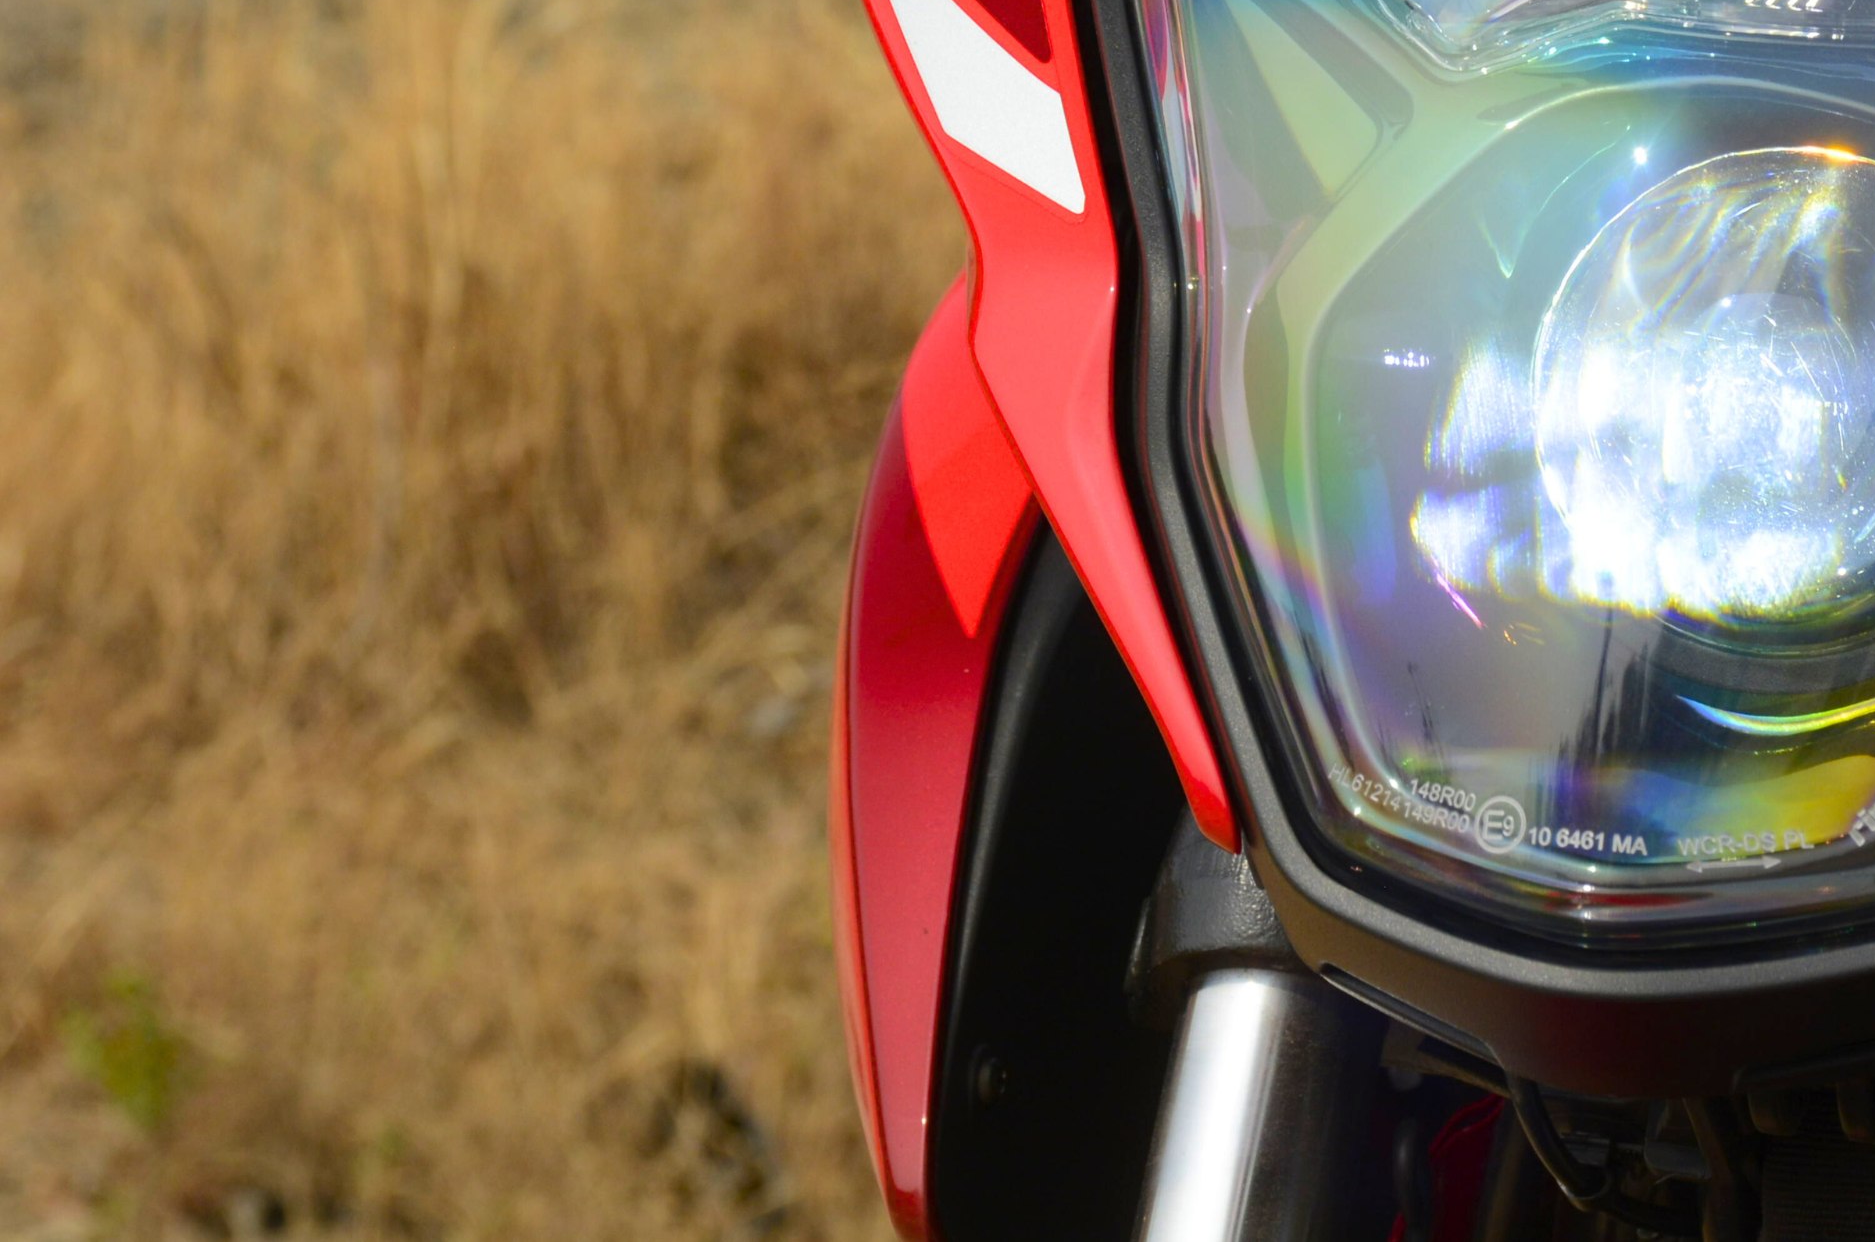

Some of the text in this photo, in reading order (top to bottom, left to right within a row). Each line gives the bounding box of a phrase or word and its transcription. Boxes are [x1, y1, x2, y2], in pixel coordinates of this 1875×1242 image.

[1327, 763, 1401, 812] HL61214
[1410, 778, 1477, 812] 148R00
[1403, 801, 1470, 834] 149R00
[1528, 826, 1648, 857] 10 6461 MA
[1677, 829, 1815, 856] WCR-DS PL
